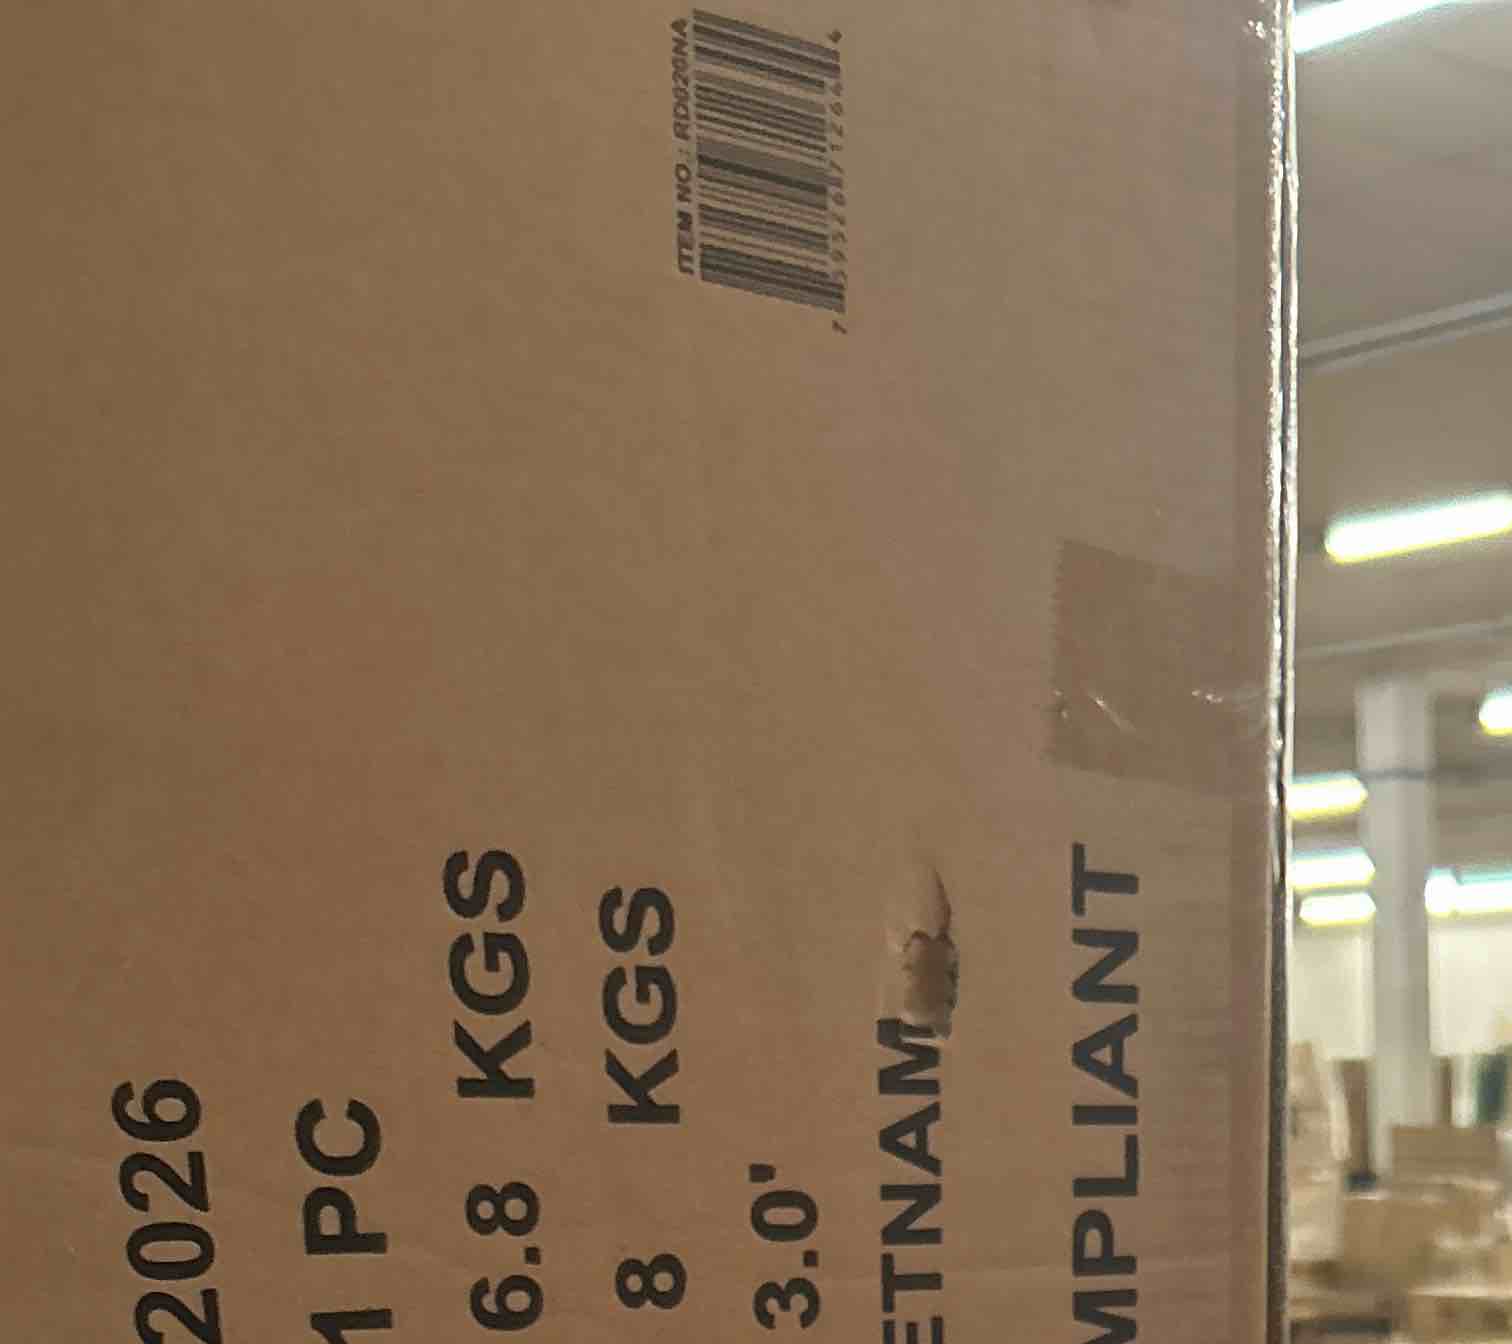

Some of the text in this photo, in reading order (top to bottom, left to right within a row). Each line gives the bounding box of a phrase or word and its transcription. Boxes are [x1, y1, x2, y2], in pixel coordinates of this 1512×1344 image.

[442, 848, 535, 1099] KGS
[598, 886, 681, 1125] KGS
[294, 1097, 389, 1258] PC
[465, 1181, 544, 1331] 6.8
[614, 1253, 688, 1310] 8
